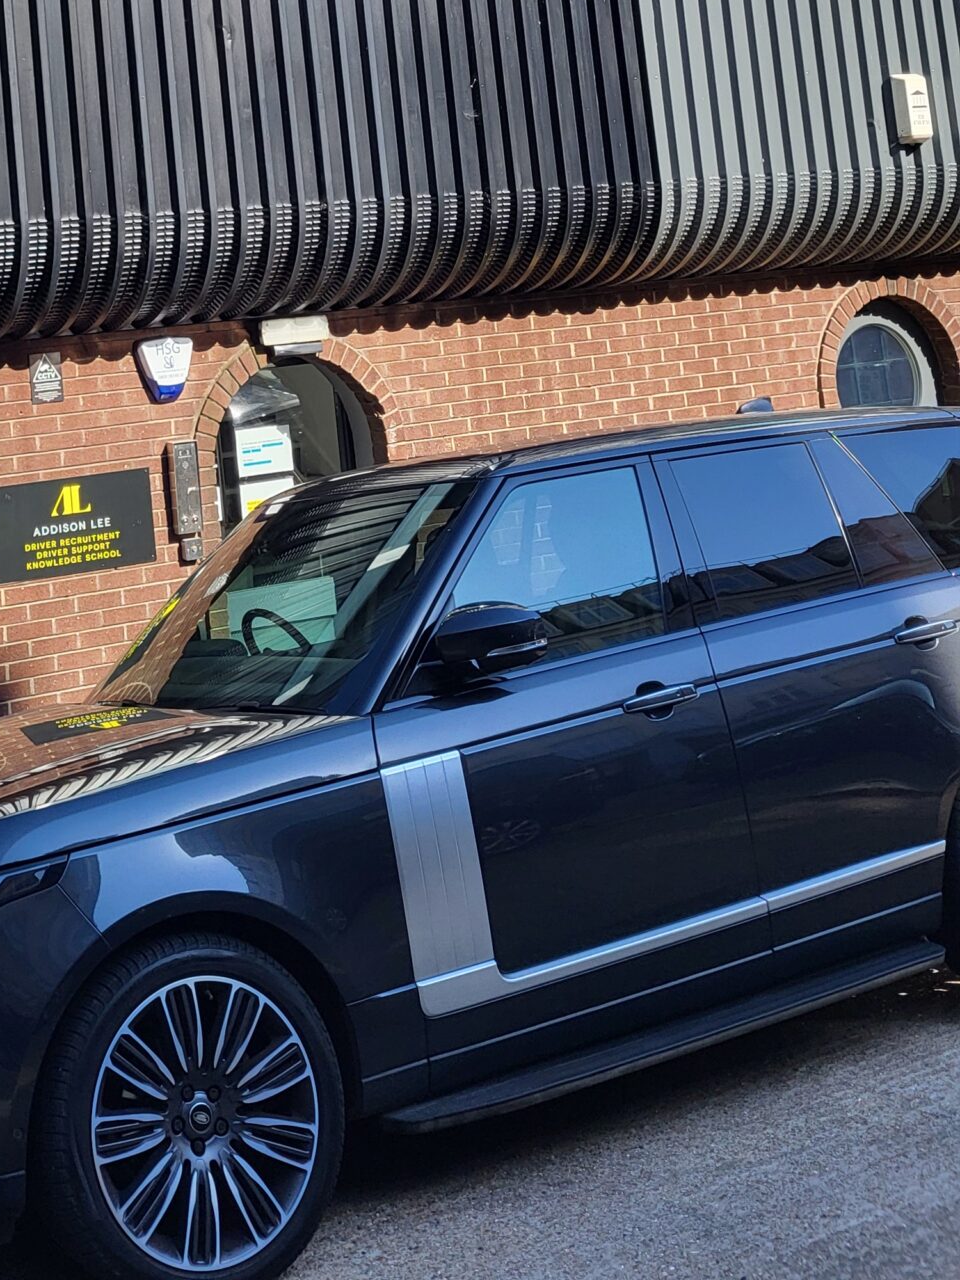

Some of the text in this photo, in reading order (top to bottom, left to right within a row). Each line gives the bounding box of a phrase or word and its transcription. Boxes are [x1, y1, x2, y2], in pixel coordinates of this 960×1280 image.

[155, 342, 181, 356] HSG
[37, 371, 57, 380] CCTV
[51, 485, 92, 517] AL
[33, 517, 111, 537] ADDISON LEE
[25, 531, 120, 552] DRIVER RECRUITMENT
[36, 542, 110, 560] DRIVER SUPPORT
[26, 550, 121, 570] KNOWLEDGE SCHOOL
